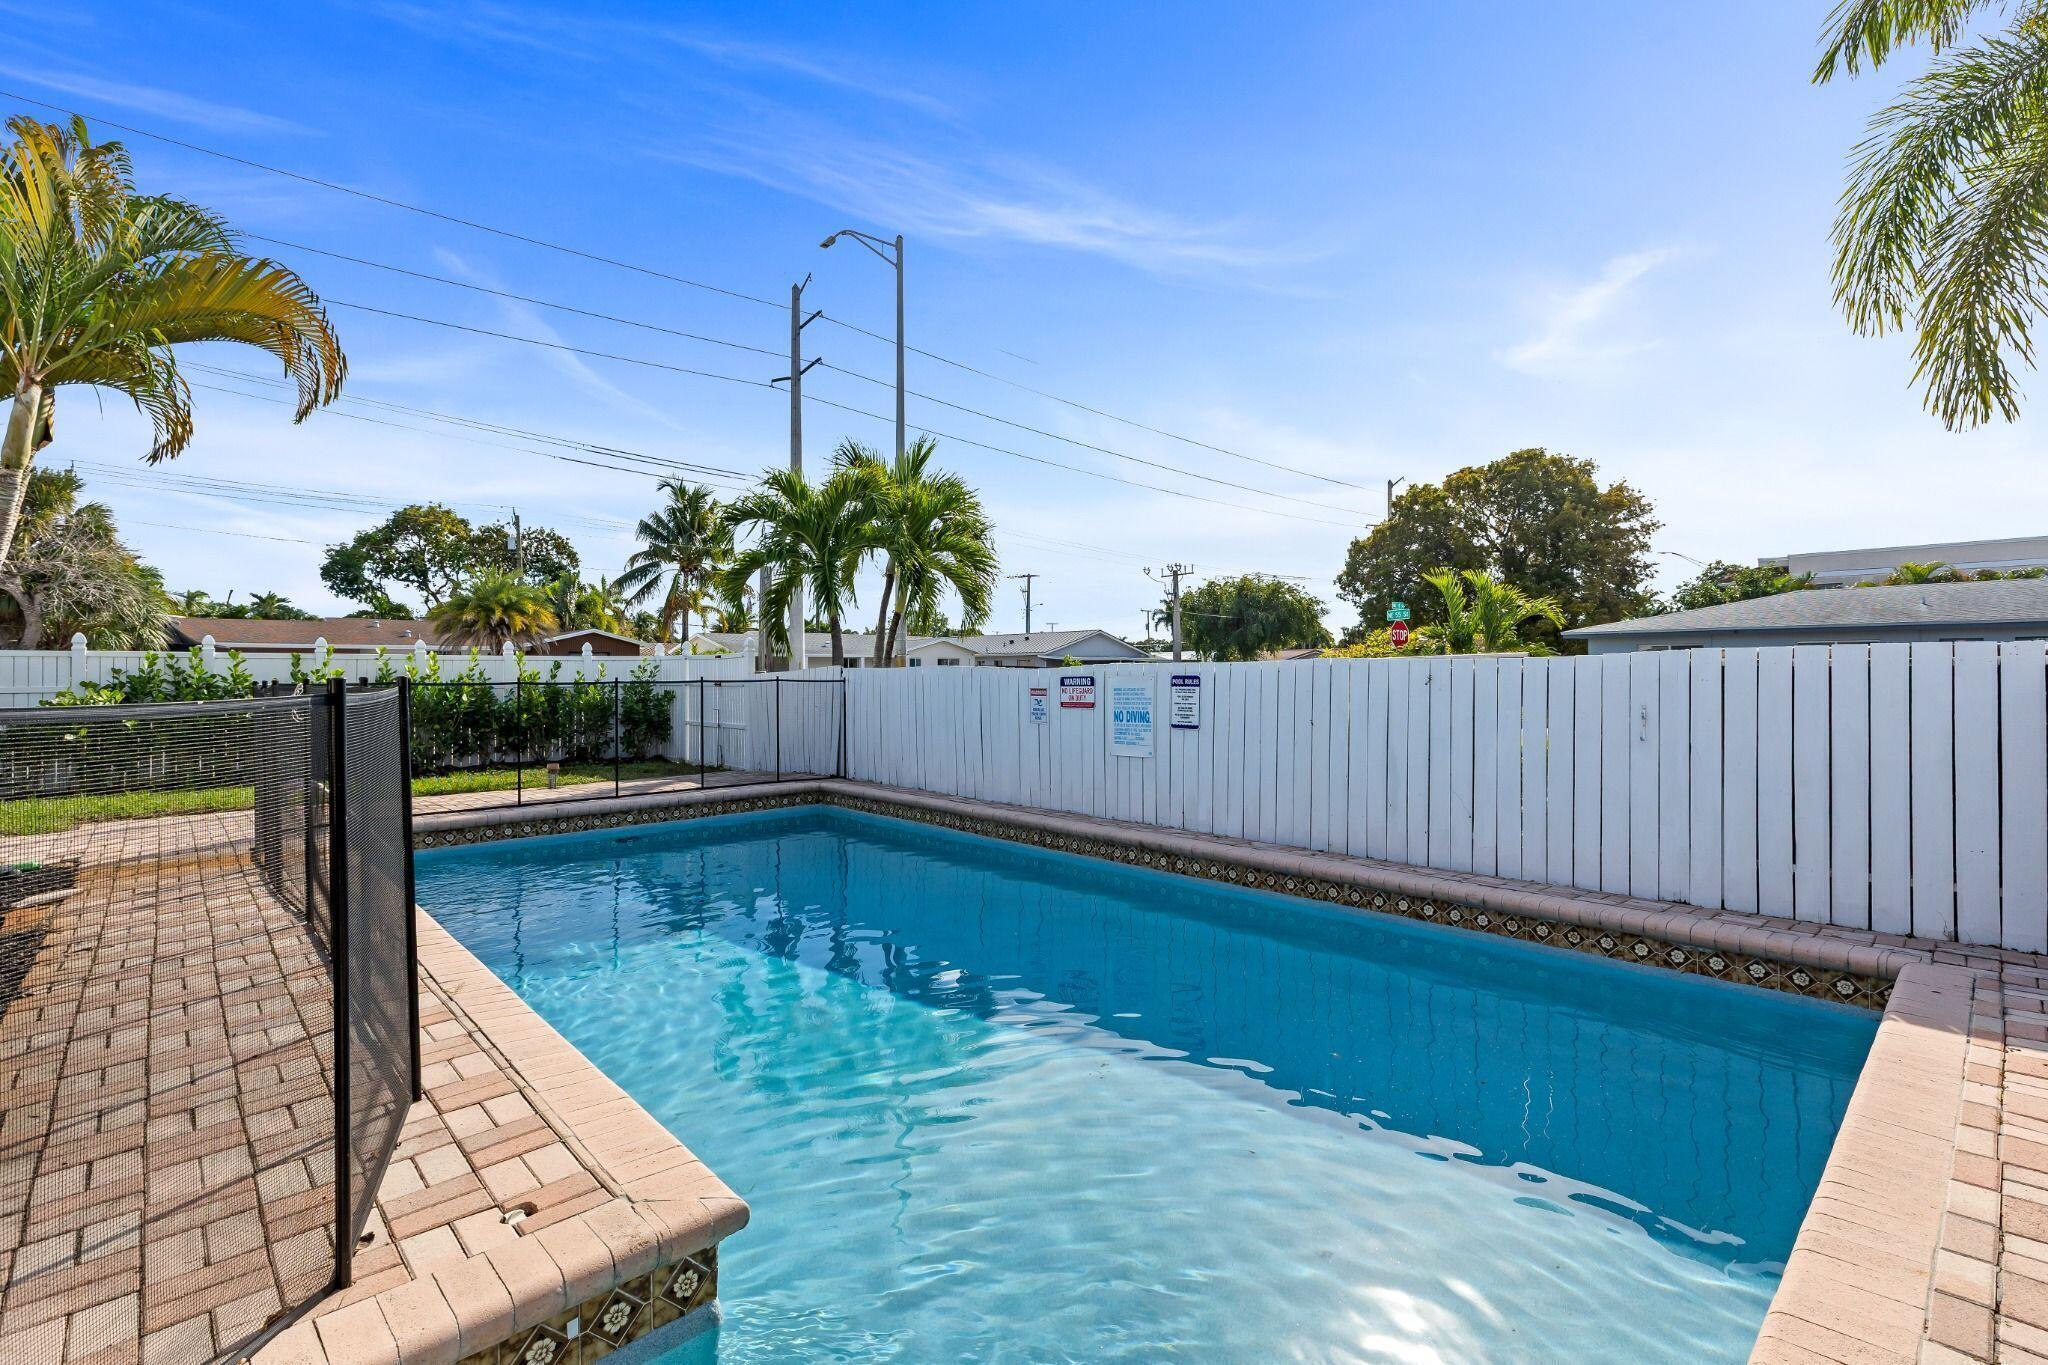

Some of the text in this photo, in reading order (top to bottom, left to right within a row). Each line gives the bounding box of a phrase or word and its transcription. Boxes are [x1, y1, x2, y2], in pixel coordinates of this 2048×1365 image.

[1392, 630, 1408, 641] STOP
[1063, 678, 1091, 686] WARNING
[1114, 711, 1152, 723] NO DIVING.
